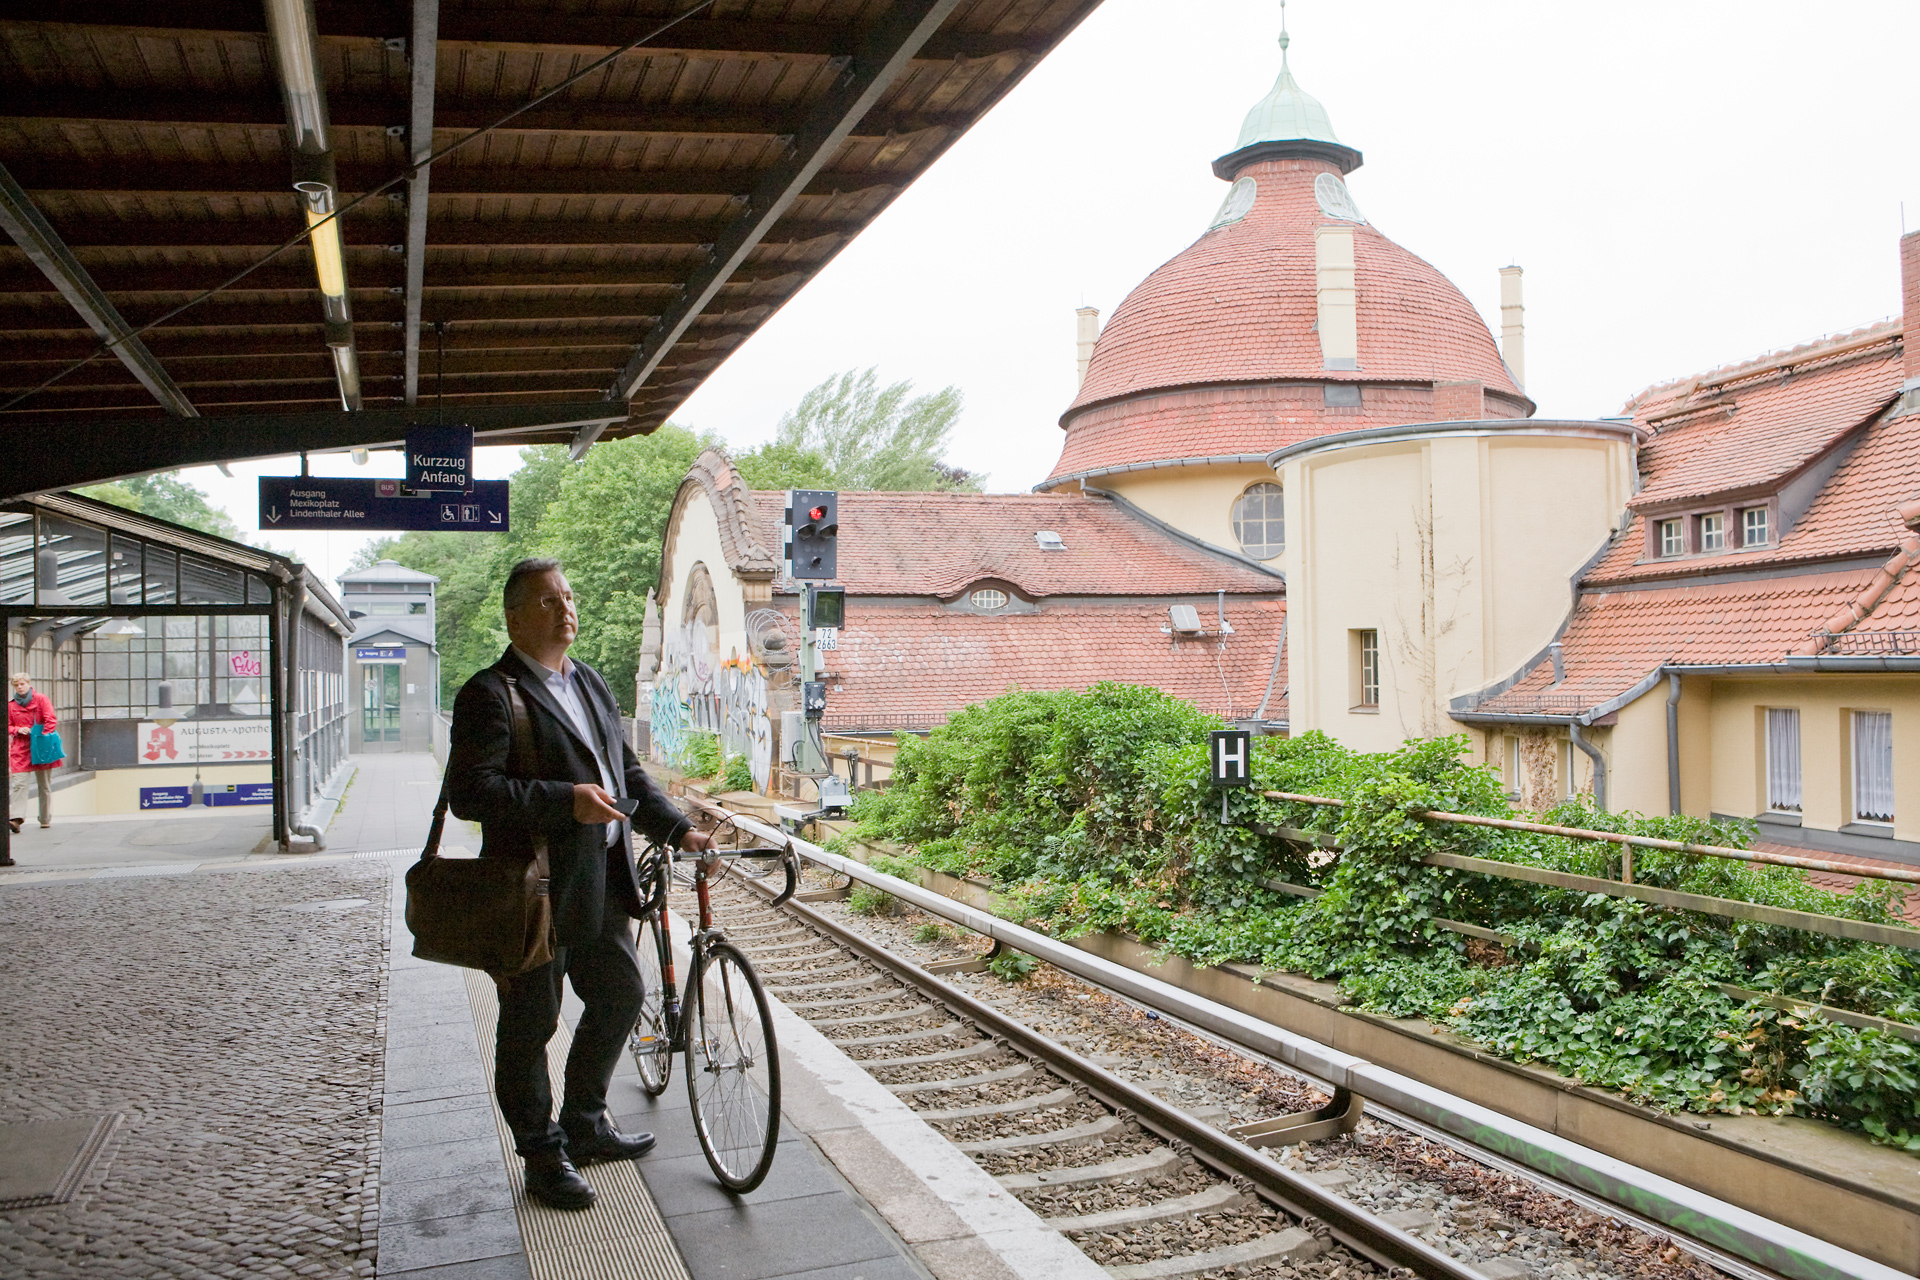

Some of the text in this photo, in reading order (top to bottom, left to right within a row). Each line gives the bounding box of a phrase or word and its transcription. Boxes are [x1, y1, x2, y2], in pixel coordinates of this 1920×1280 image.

[413, 454, 466, 470] Kurzzug
[420, 470, 466, 485] Anfang
[290, 489, 326, 499] Ausgang
[290, 499, 340, 508] Mexikoplatz
[290, 509, 365, 518] Lindenthaler Allee
[822, 628, 831, 639] 72
[817, 639, 836, 650] 2663
[181, 725, 270, 736] AUGUSTA-APOTHE
[1219, 737, 1245, 778] H
